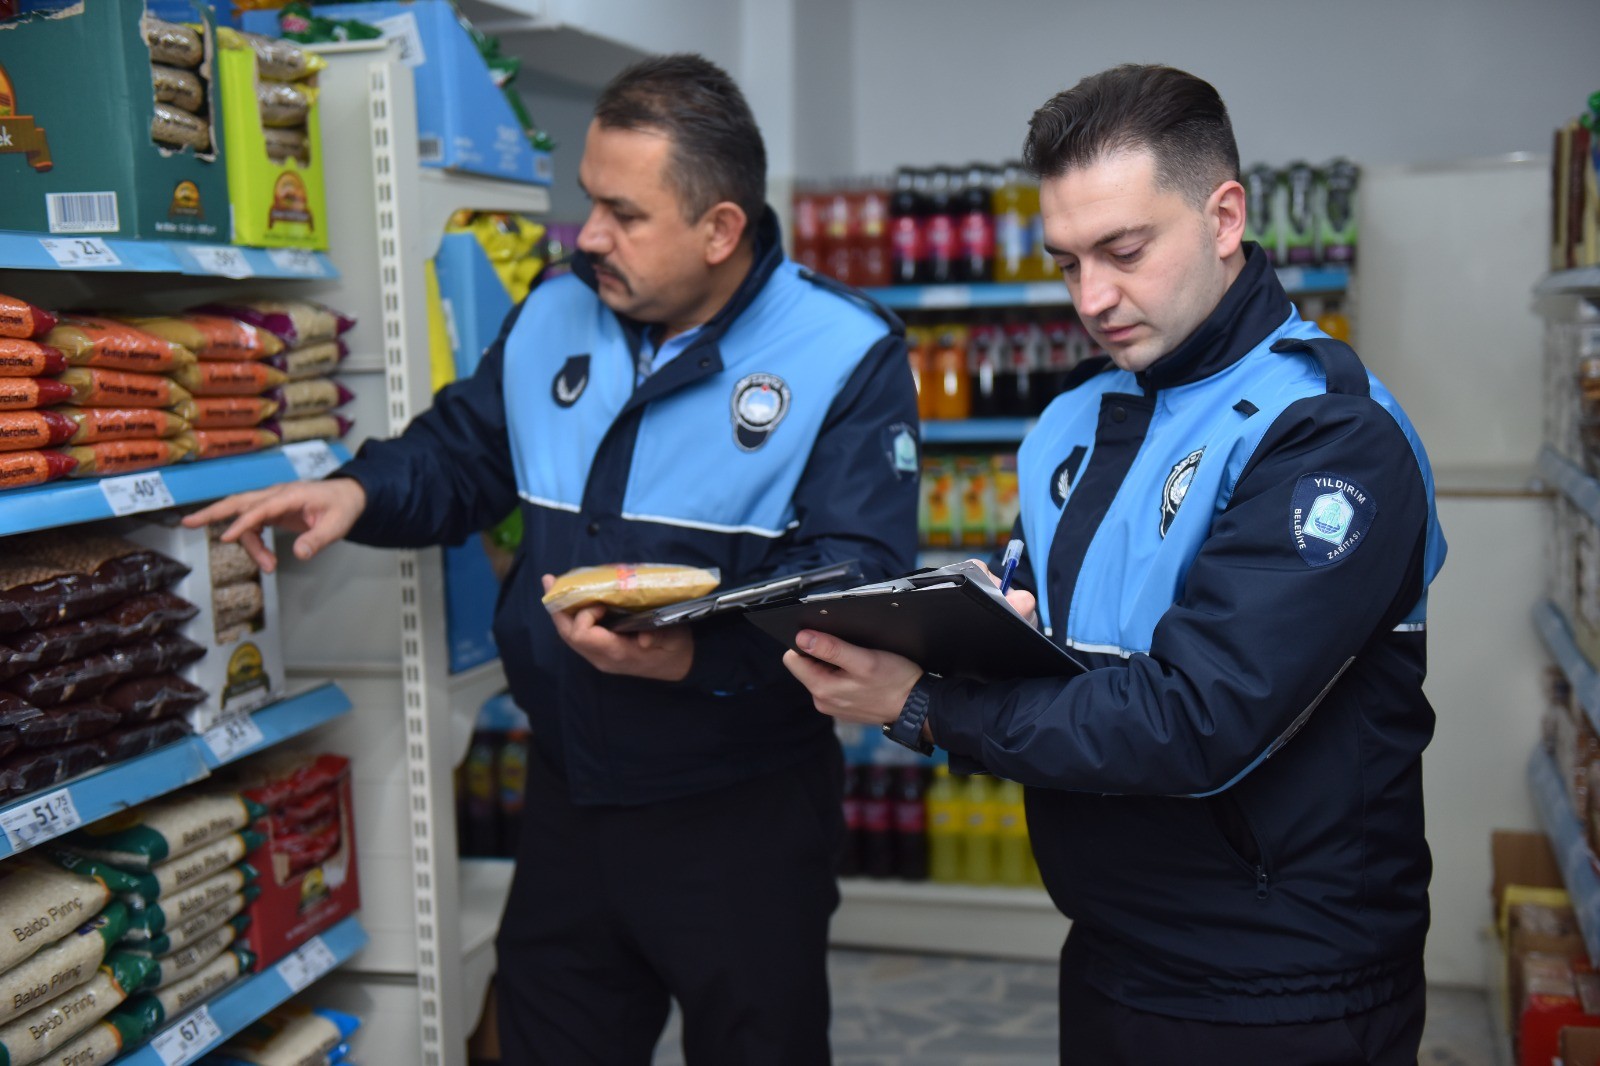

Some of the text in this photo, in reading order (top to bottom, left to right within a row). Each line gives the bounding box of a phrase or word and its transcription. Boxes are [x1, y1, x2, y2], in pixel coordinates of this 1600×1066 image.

[134, 479, 154, 497] 40
[1314, 478, 1366, 505] YILDIRIM
[1327, 530, 1361, 560] ZABITASI
[32, 802, 58, 826] 51
[13, 896, 83, 943] Baldo Pirinç
[13, 964, 82, 1009] Baldo Pirinç
[29, 993, 95, 1040] Baldo Pirinç
[180, 1020, 199, 1041] 67
